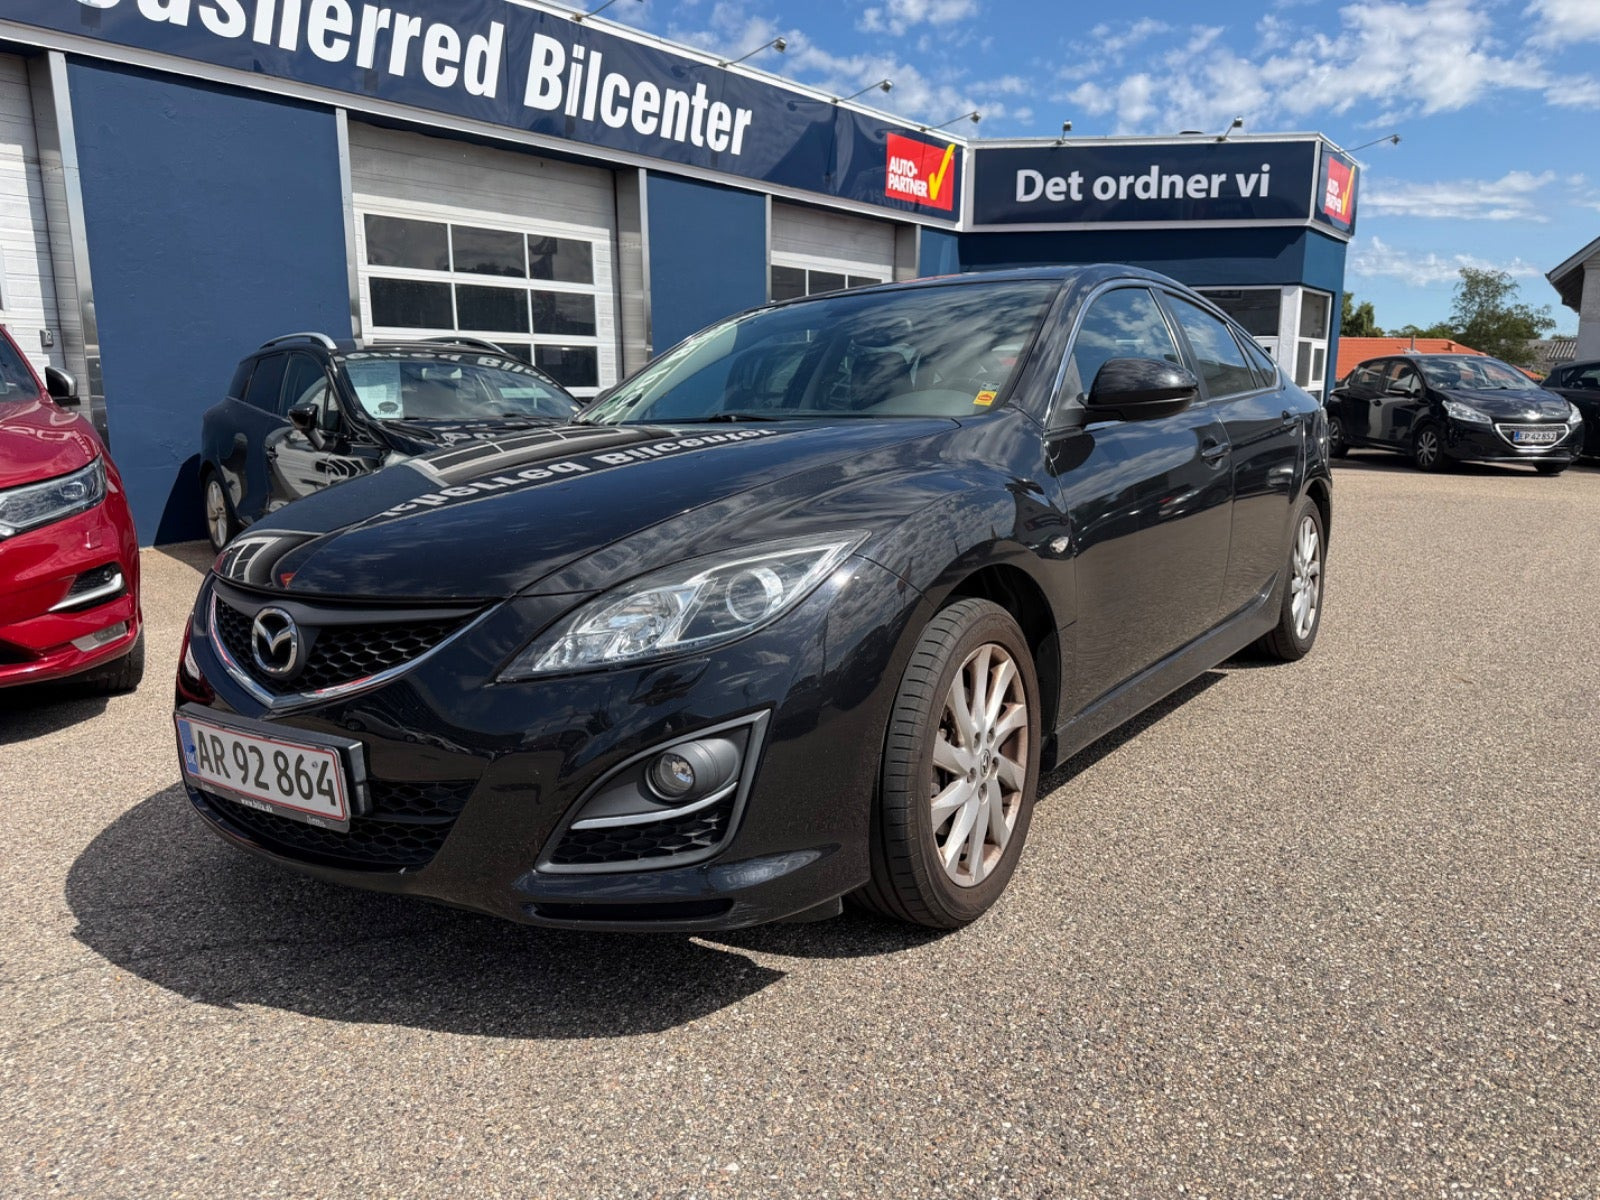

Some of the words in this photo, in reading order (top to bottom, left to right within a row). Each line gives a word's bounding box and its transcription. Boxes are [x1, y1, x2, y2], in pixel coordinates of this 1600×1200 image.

[524, 33, 752, 155] Bilcenter
[887, 173, 928, 198] PARTNER
[889, 156, 918, 178] AUTO-
[1016, 169, 1084, 202] Det
[1092, 165, 1227, 201] ordner
[1235, 163, 1270, 197] vi
[197, 730, 231, 779] AR
[232, 741, 270, 791] 92
[273, 750, 337, 807] 864
